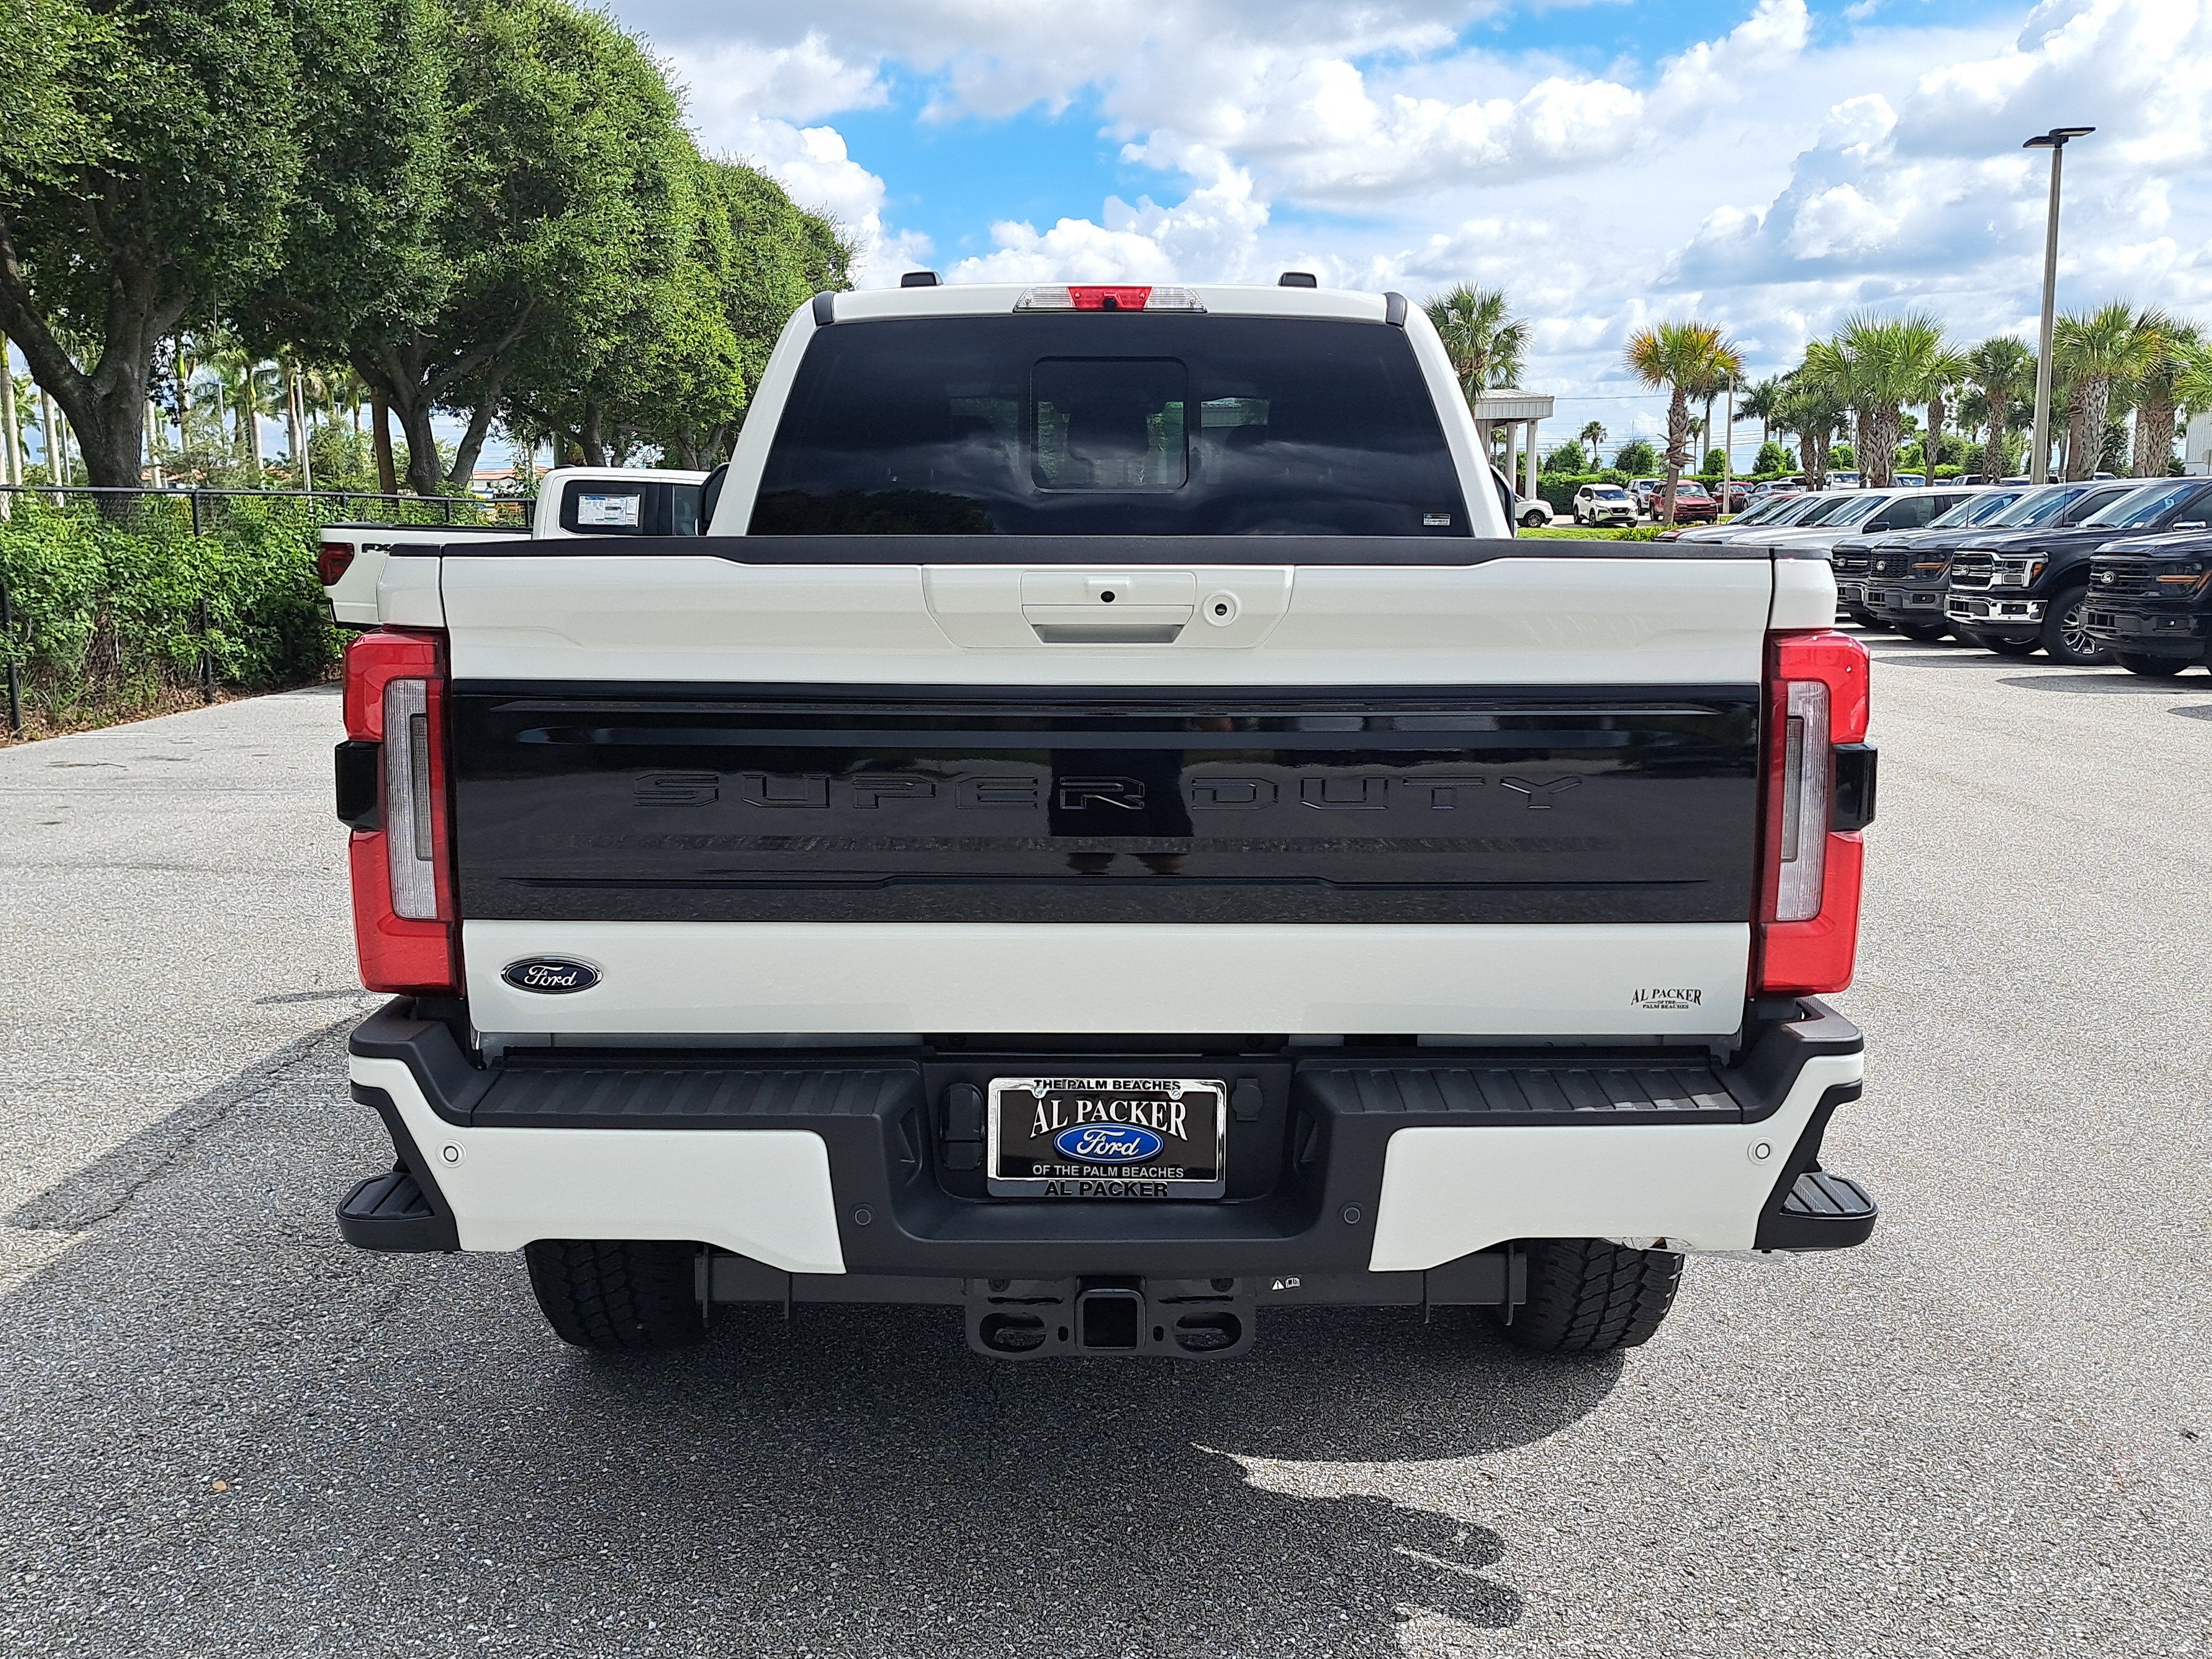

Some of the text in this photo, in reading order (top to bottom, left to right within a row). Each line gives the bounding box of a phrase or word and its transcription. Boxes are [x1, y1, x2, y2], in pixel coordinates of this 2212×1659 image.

[361, 543, 391, 553] FX
[634, 772, 1582, 809] SUPER DUTY
[524, 965, 577, 986] Ford
[1630, 988, 1702, 1006] AL PACKER
[1033, 1079, 1181, 1090] THE PALM BEACHES
[1029, 1100, 1189, 1141] AL PACKER
[1076, 1128, 1142, 1156] Ford
[1032, 1164, 1184, 1178] OF THE PALM BEACHES
[1044, 1180, 1169, 1196] AL PACKER
